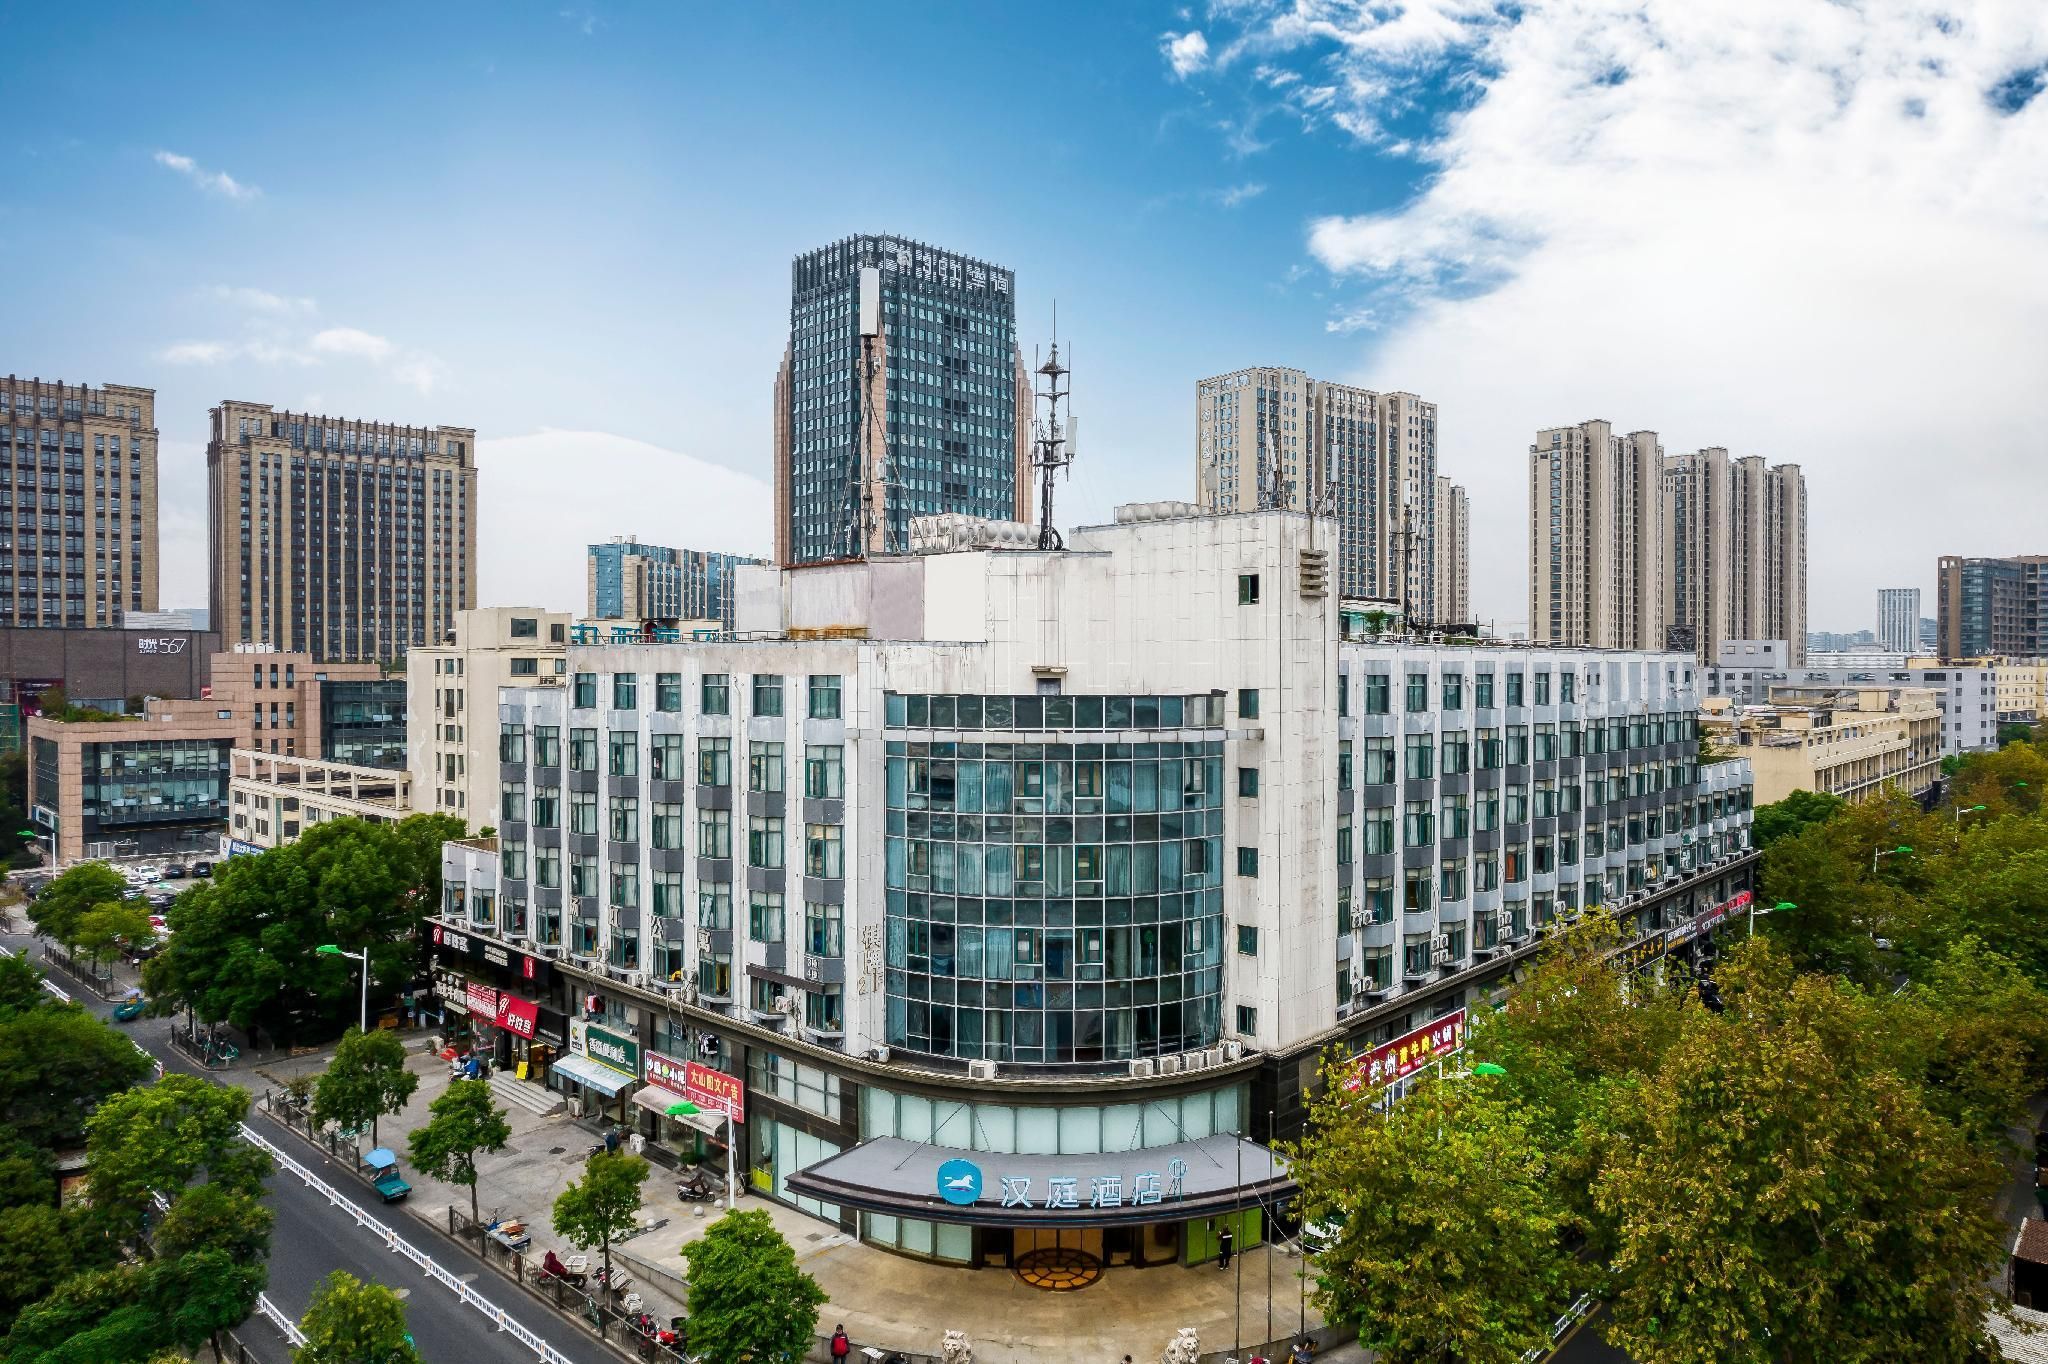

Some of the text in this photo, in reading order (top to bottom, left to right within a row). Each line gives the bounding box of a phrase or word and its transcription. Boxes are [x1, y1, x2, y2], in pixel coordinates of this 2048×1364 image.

[138, 638, 187, 654] 时光 567
[690, 1068, 739, 1101] 大山图文广告
[1000, 1172, 1162, 1209] 汉庭酒店
